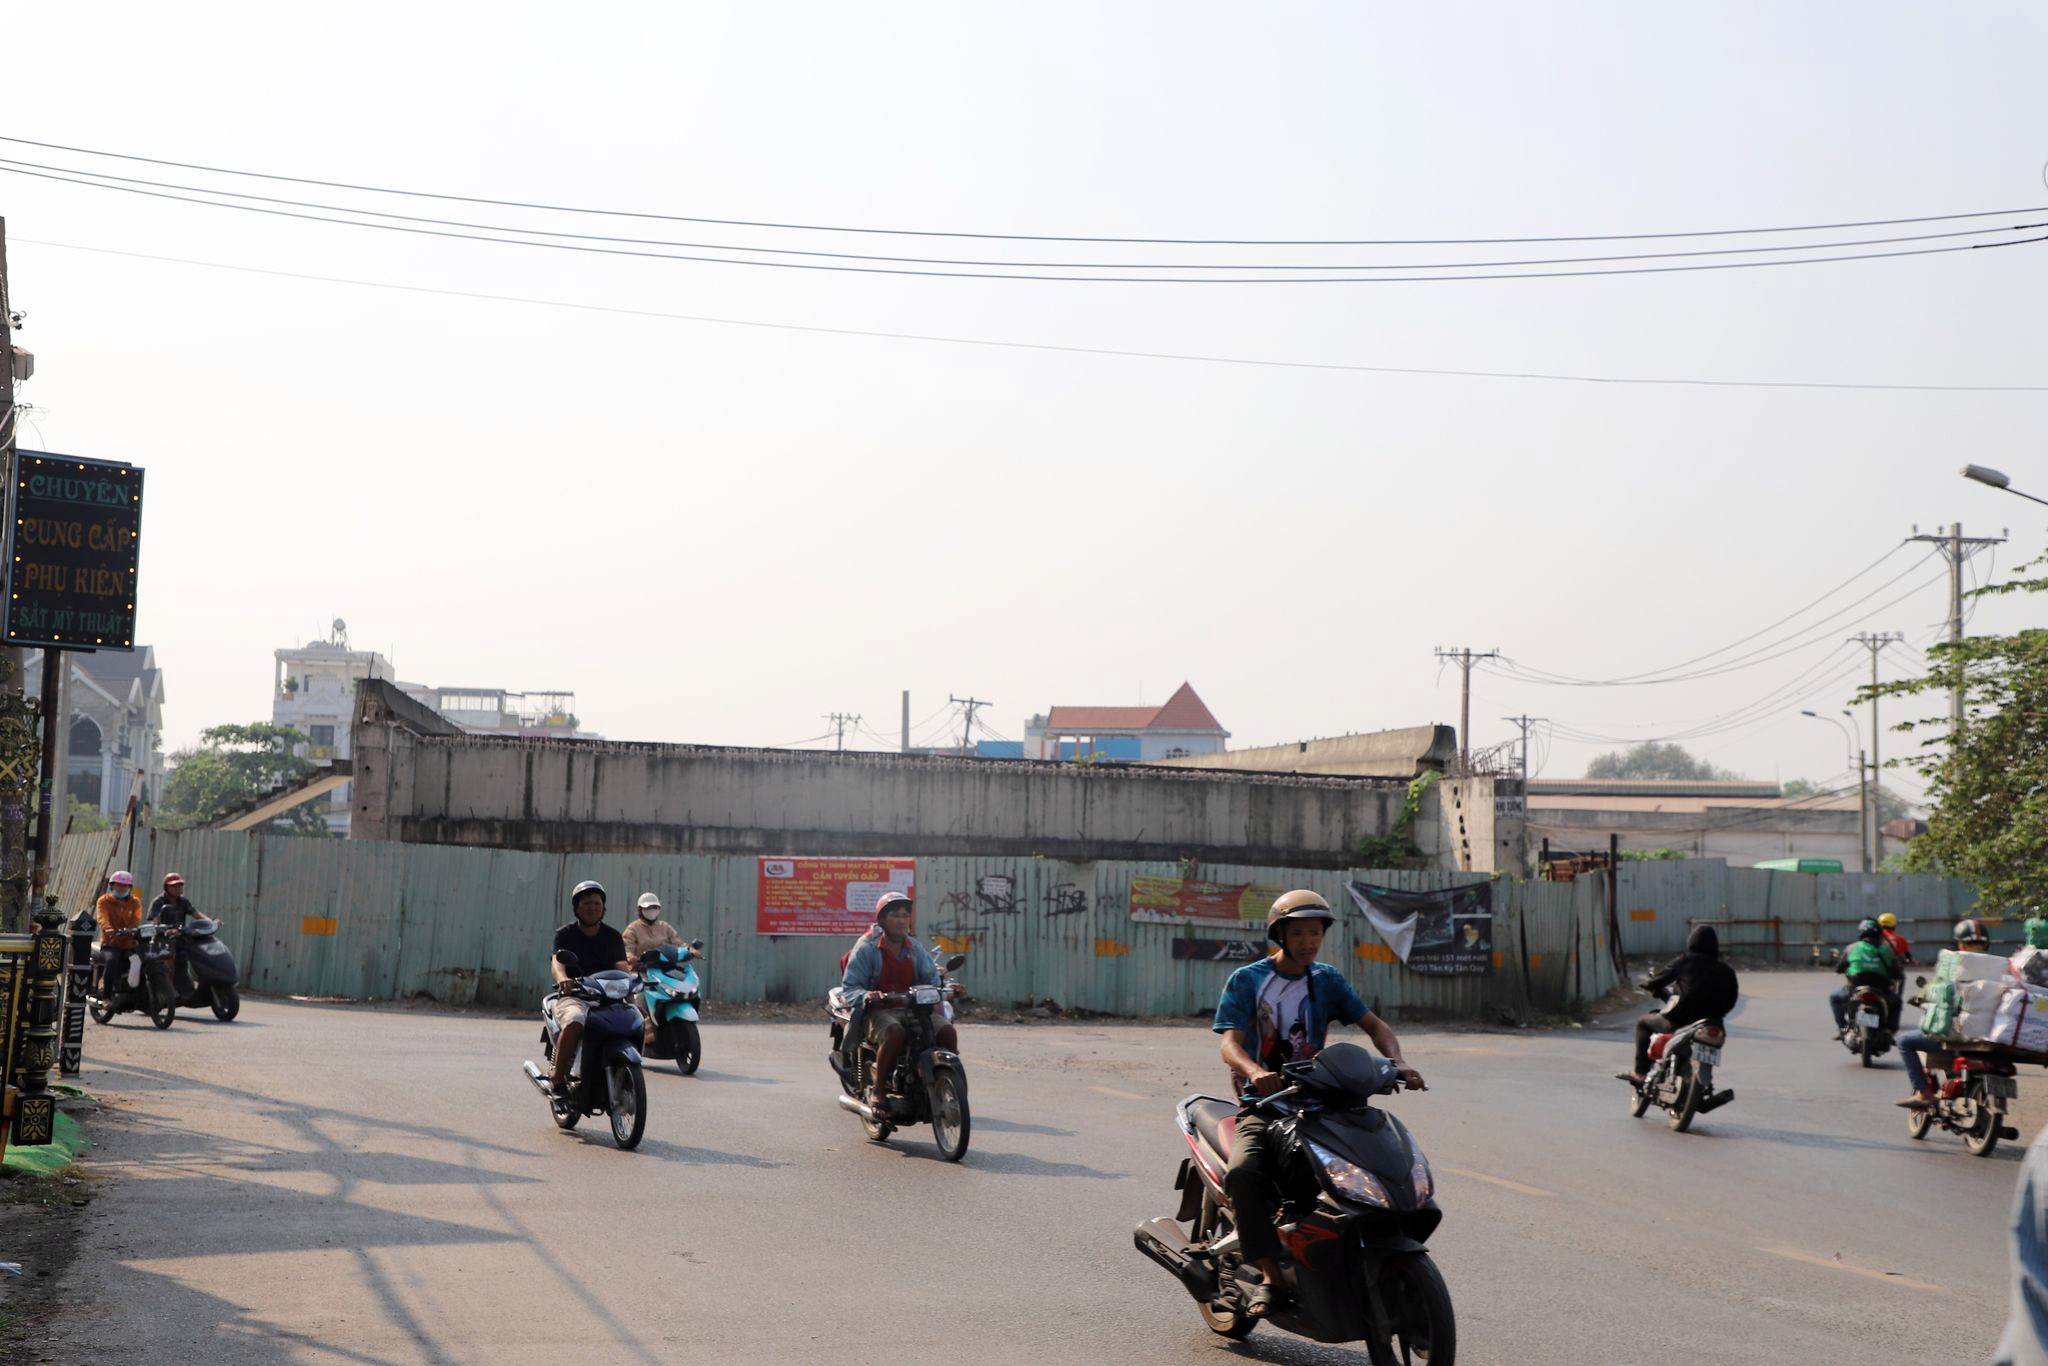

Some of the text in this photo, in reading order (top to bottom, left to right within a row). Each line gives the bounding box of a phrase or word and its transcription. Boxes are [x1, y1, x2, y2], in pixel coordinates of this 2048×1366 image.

[29, 474, 130, 506] CHUYÊN
[23, 517, 130, 553] CUNG CẤP
[24, 562, 125, 600] PHỤ KIỆN
